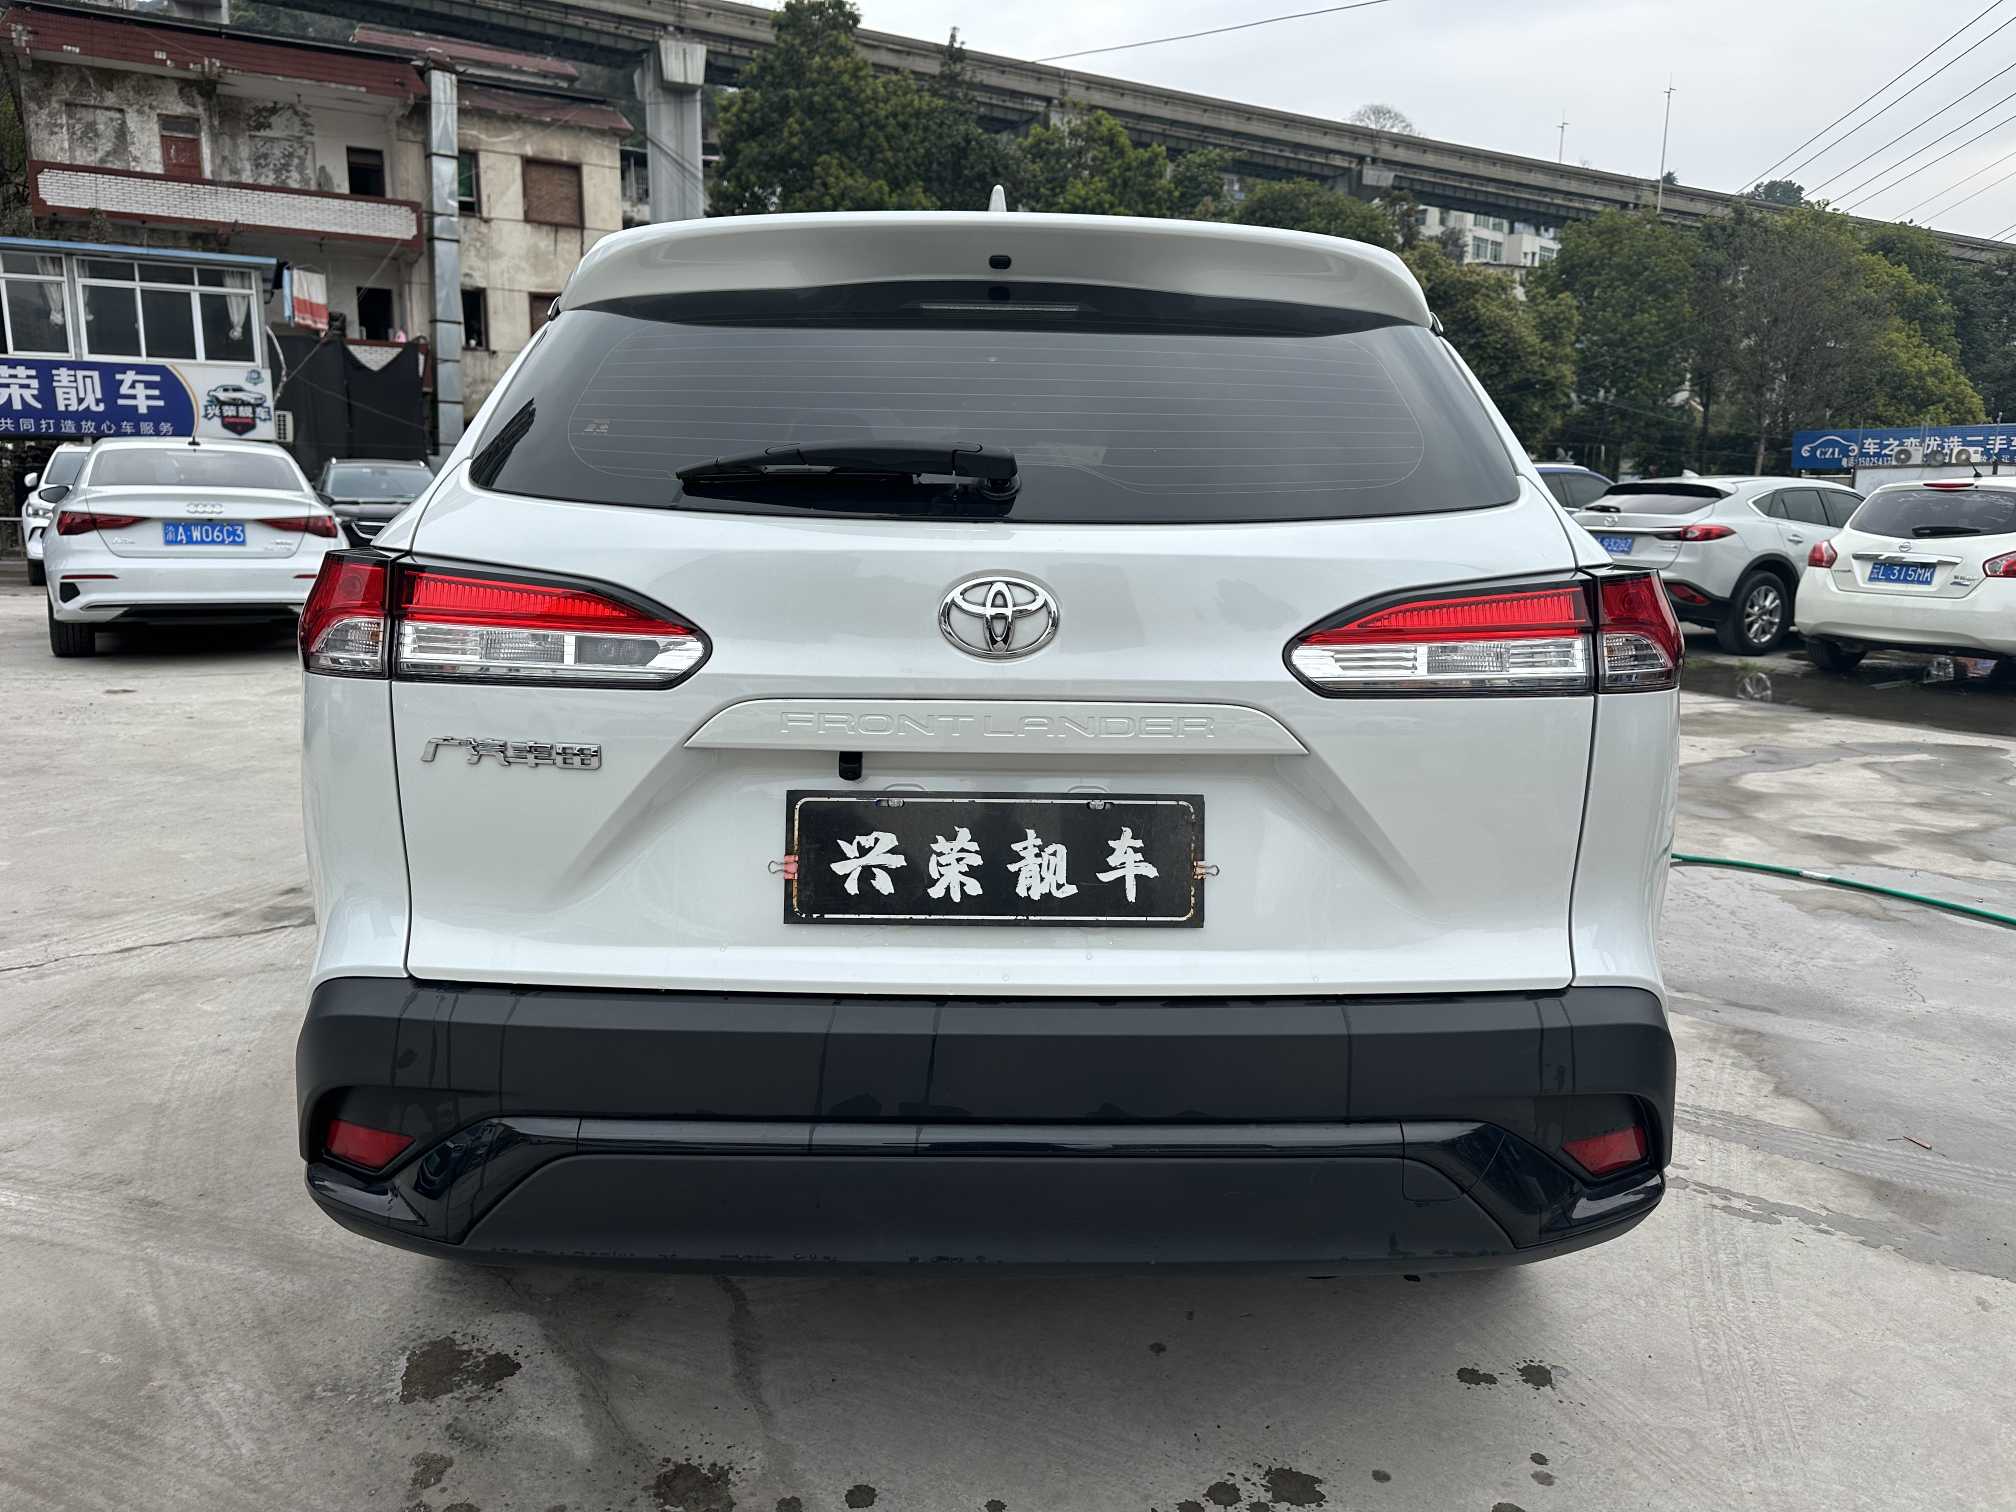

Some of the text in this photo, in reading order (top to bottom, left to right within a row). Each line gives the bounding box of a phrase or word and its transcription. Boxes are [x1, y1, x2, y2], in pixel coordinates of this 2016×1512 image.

[0, 366, 165, 414] 荣靓车
[0, 418, 174, 436] 共同打造放心车服务
[1816, 447, 1842, 459] CZL
[421, 736, 602, 770] 广汽丰田
[830, 826, 1159, 903] 兴荣靓车
